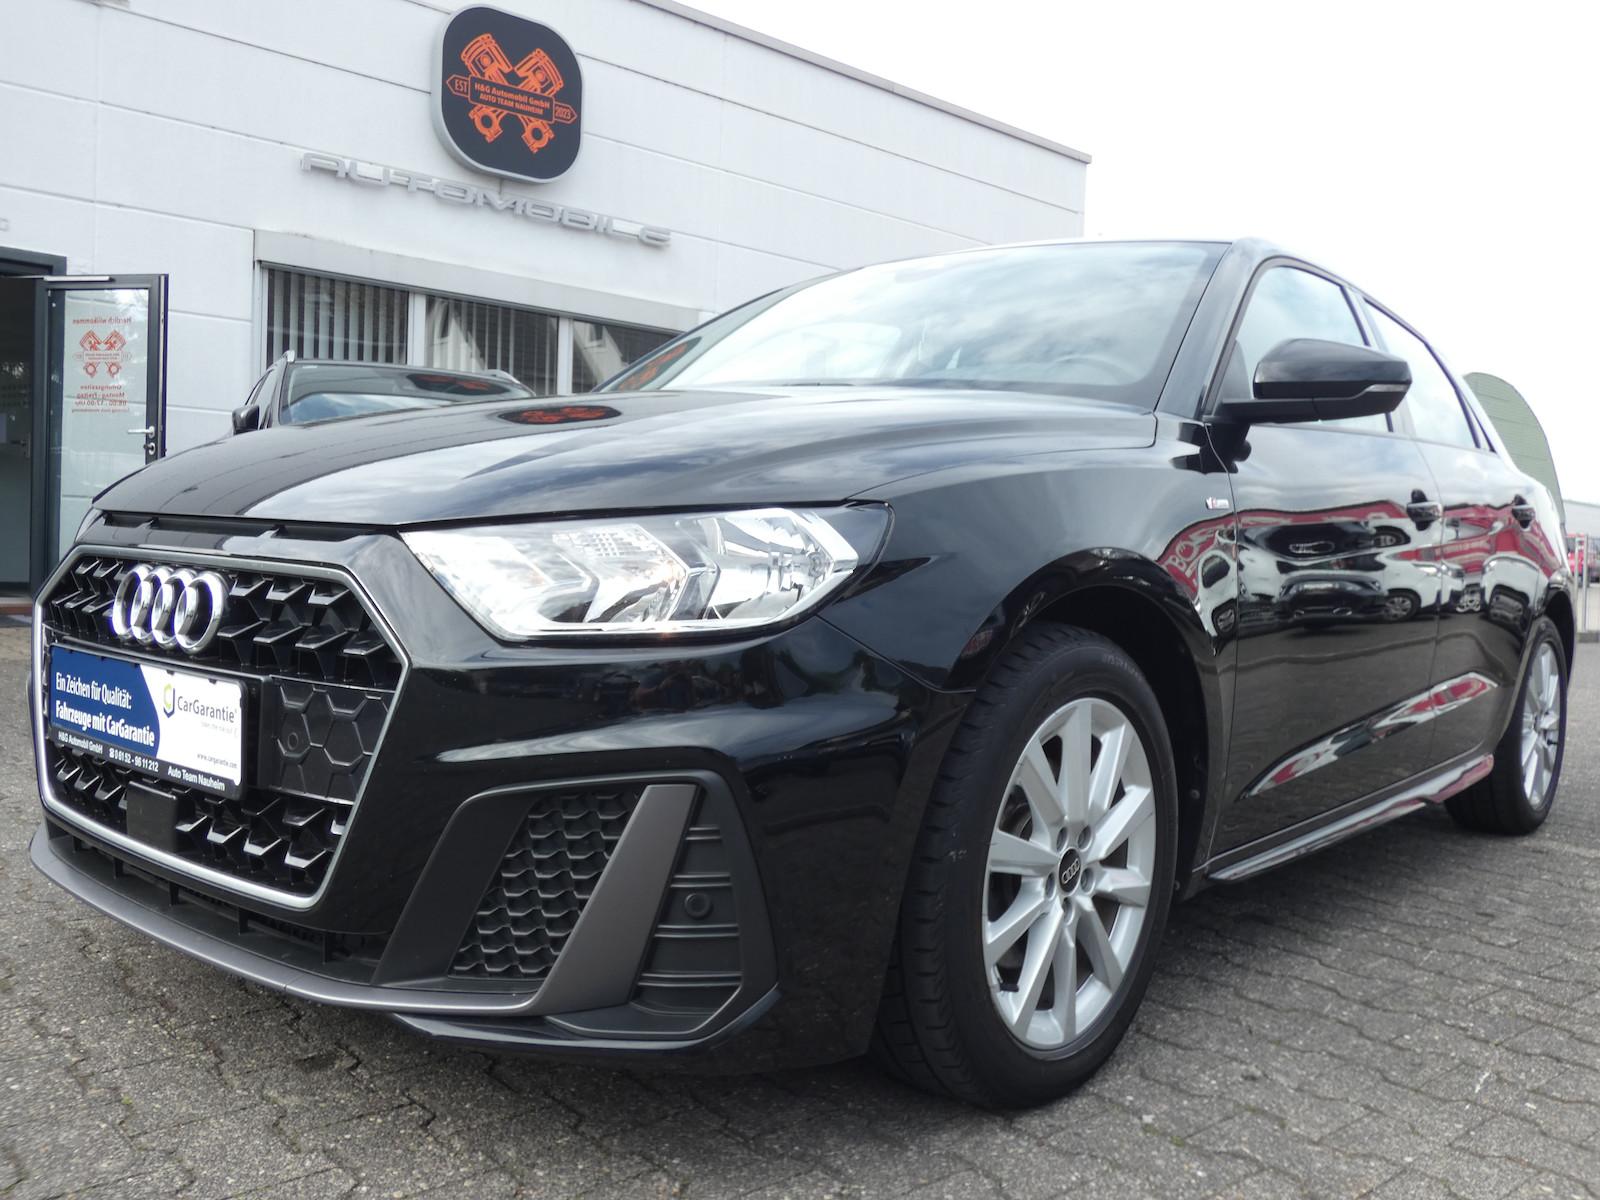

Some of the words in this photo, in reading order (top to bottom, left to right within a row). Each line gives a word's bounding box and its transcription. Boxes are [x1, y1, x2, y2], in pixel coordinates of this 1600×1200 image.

[454, 79, 468, 93] EST
[491, 86, 528, 103] Automobil
[528, 97, 550, 109] GmbH
[479, 93, 497, 103] AUTO
[497, 97, 514, 108] TEAM
[55, 672, 66, 691] Ein
[66, 674, 91, 699] Zeichen
[91, 682, 102, 700] für
[101, 684, 132, 710] Qualität:
[177, 696, 235, 723] CarGarantie
[55, 700, 92, 731] Fahrzeuge
[92, 713, 106, 732] mit
[106, 717, 155, 747] CarGarantie
[68, 734, 89, 749] Automobil
[89, 741, 103, 754] GmbH
[167, 765, 181, 779] Auto
[181, 769, 198, 784] Team
[198, 773, 225, 791] Nauheim
